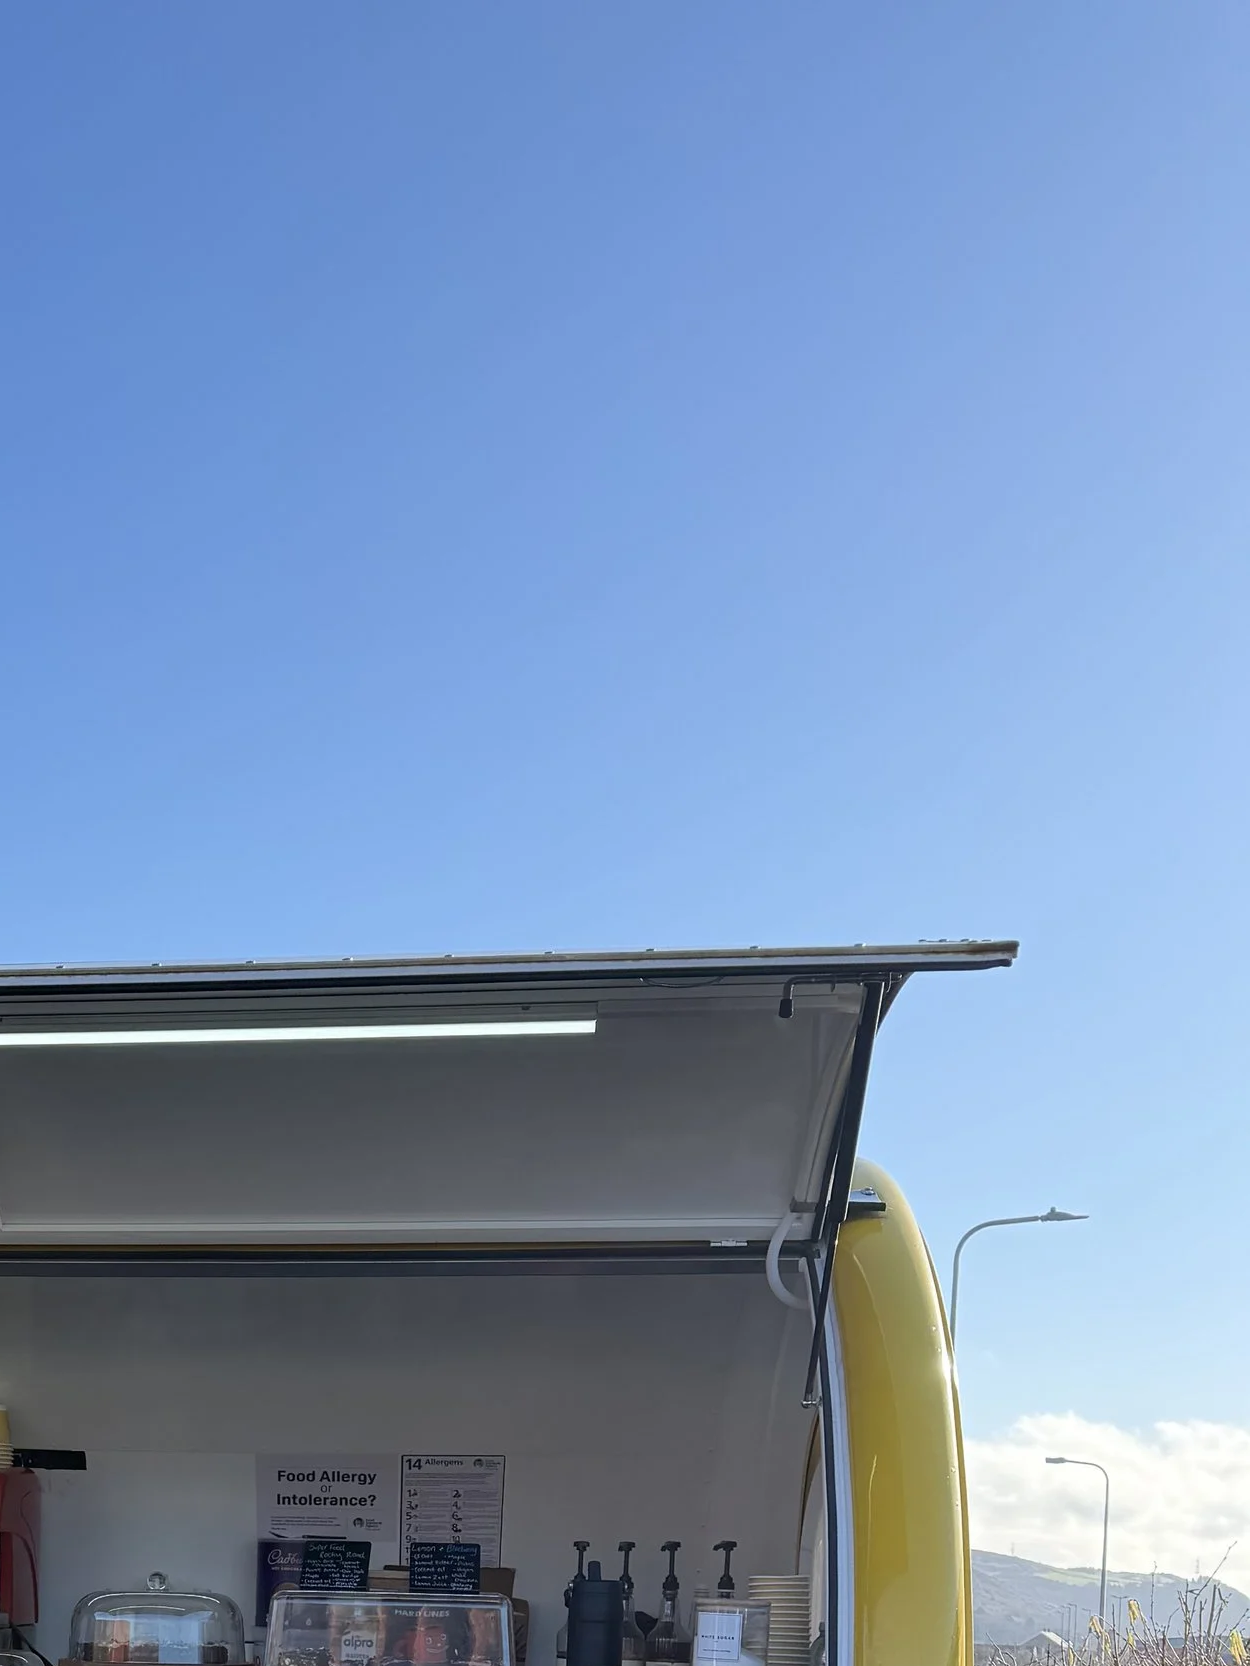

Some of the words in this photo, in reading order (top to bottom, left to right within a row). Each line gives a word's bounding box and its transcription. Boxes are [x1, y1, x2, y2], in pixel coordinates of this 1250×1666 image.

[405, 1458, 422, 1470] 14
[424, 1458, 463, 1466] Allergens
[277, 1470, 316, 1482] Food
[319, 1470, 377, 1485] Allergy
[320, 1484, 332, 1493] or
[276, 1493, 377, 1506] Intolerance?
[411, 1544, 436, 1552] Lemon
[343, 1636, 374, 1650] alpro
